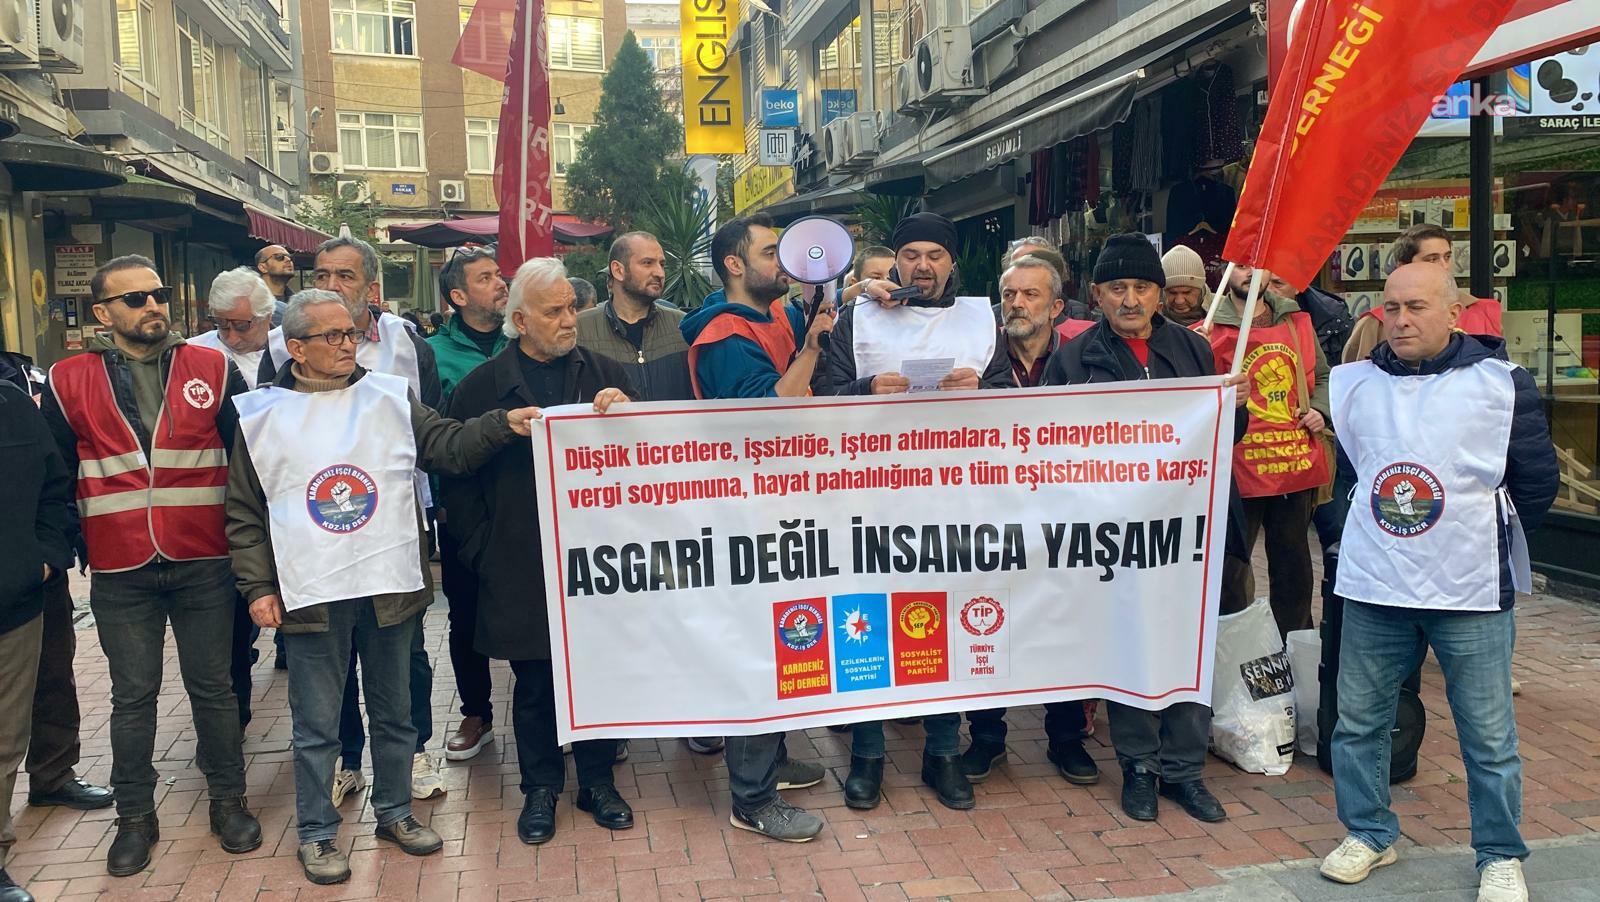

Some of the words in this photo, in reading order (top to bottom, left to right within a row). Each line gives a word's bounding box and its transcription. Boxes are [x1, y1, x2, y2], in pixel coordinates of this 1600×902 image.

[1290, 3, 1384, 158] ERNEĞİ
[766, 99, 795, 111] beko
[1539, 117, 1580, 130] SARAÇ
[986, 129, 1022, 162] SEVİMLİ
[190, 385, 206, 396] TİP
[1267, 390, 1287, 403] SEP
[565, 444, 631, 476] Düşük
[637, 440, 739, 466] ücretlere,
[744, 433, 834, 465] işsizliğe,
[841, 430, 891, 460] işten
[898, 427, 1006, 451] atılmalara,
[1012, 423, 1031, 453] iş
[1036, 420, 1181, 449] cinayetlerine,
[308, 470, 336, 501] KARADENİZ
[335, 467, 352, 477] İŞÇİ
[351, 470, 376, 494] DERNEĞİ
[568, 482, 622, 509] vergi
[628, 476, 748, 506] soygununa,
[753, 470, 810, 497] hayat
[816, 463, 933, 495] pahalılığına
[939, 466, 963, 486] ve
[969, 461, 1009, 485] tüm
[1015, 459, 1150, 491] eşitsizliklere
[1156, 458, 1208, 486] karşı;
[1373, 466, 1403, 495] KARADENİZ
[1402, 464, 1420, 477] İŞÇİ
[1418, 471, 1443, 500] DERNEĞİ
[322, 520, 351, 532] KDZ-İŞ
[352, 514, 368, 528] DER
[1380, 518, 1408, 536] KDZ-İŞ
[1409, 521, 1429, 534] DER
[567, 527, 715, 597] ASGARİ
[728, 518, 839, 586] DEĞİL
[851, 516, 1027, 574] İNSANCA
[1041, 517, 1183, 582] YAŞAM
[972, 605, 993, 617] TİP
[900, 648, 942, 659] SOSYALİST
[969, 643, 995, 653] TÜRKİYE
[841, 656, 885, 666] EZİLENLERİN
[900, 658, 943, 668] EMEKÇİLER
[976, 655, 989, 666] İŞÇİ
[783, 659, 825, 676] KARADENİZ
[845, 664, 882, 674] SOSYALİST
[907, 666, 937, 676] PARTİSİ
[970, 666, 995, 675] PARTİSİ
[850, 673, 877, 682] PARTİSİ
[780, 678, 796, 695] İŞÇİ
[797, 674, 829, 690] DERNEĞİ
